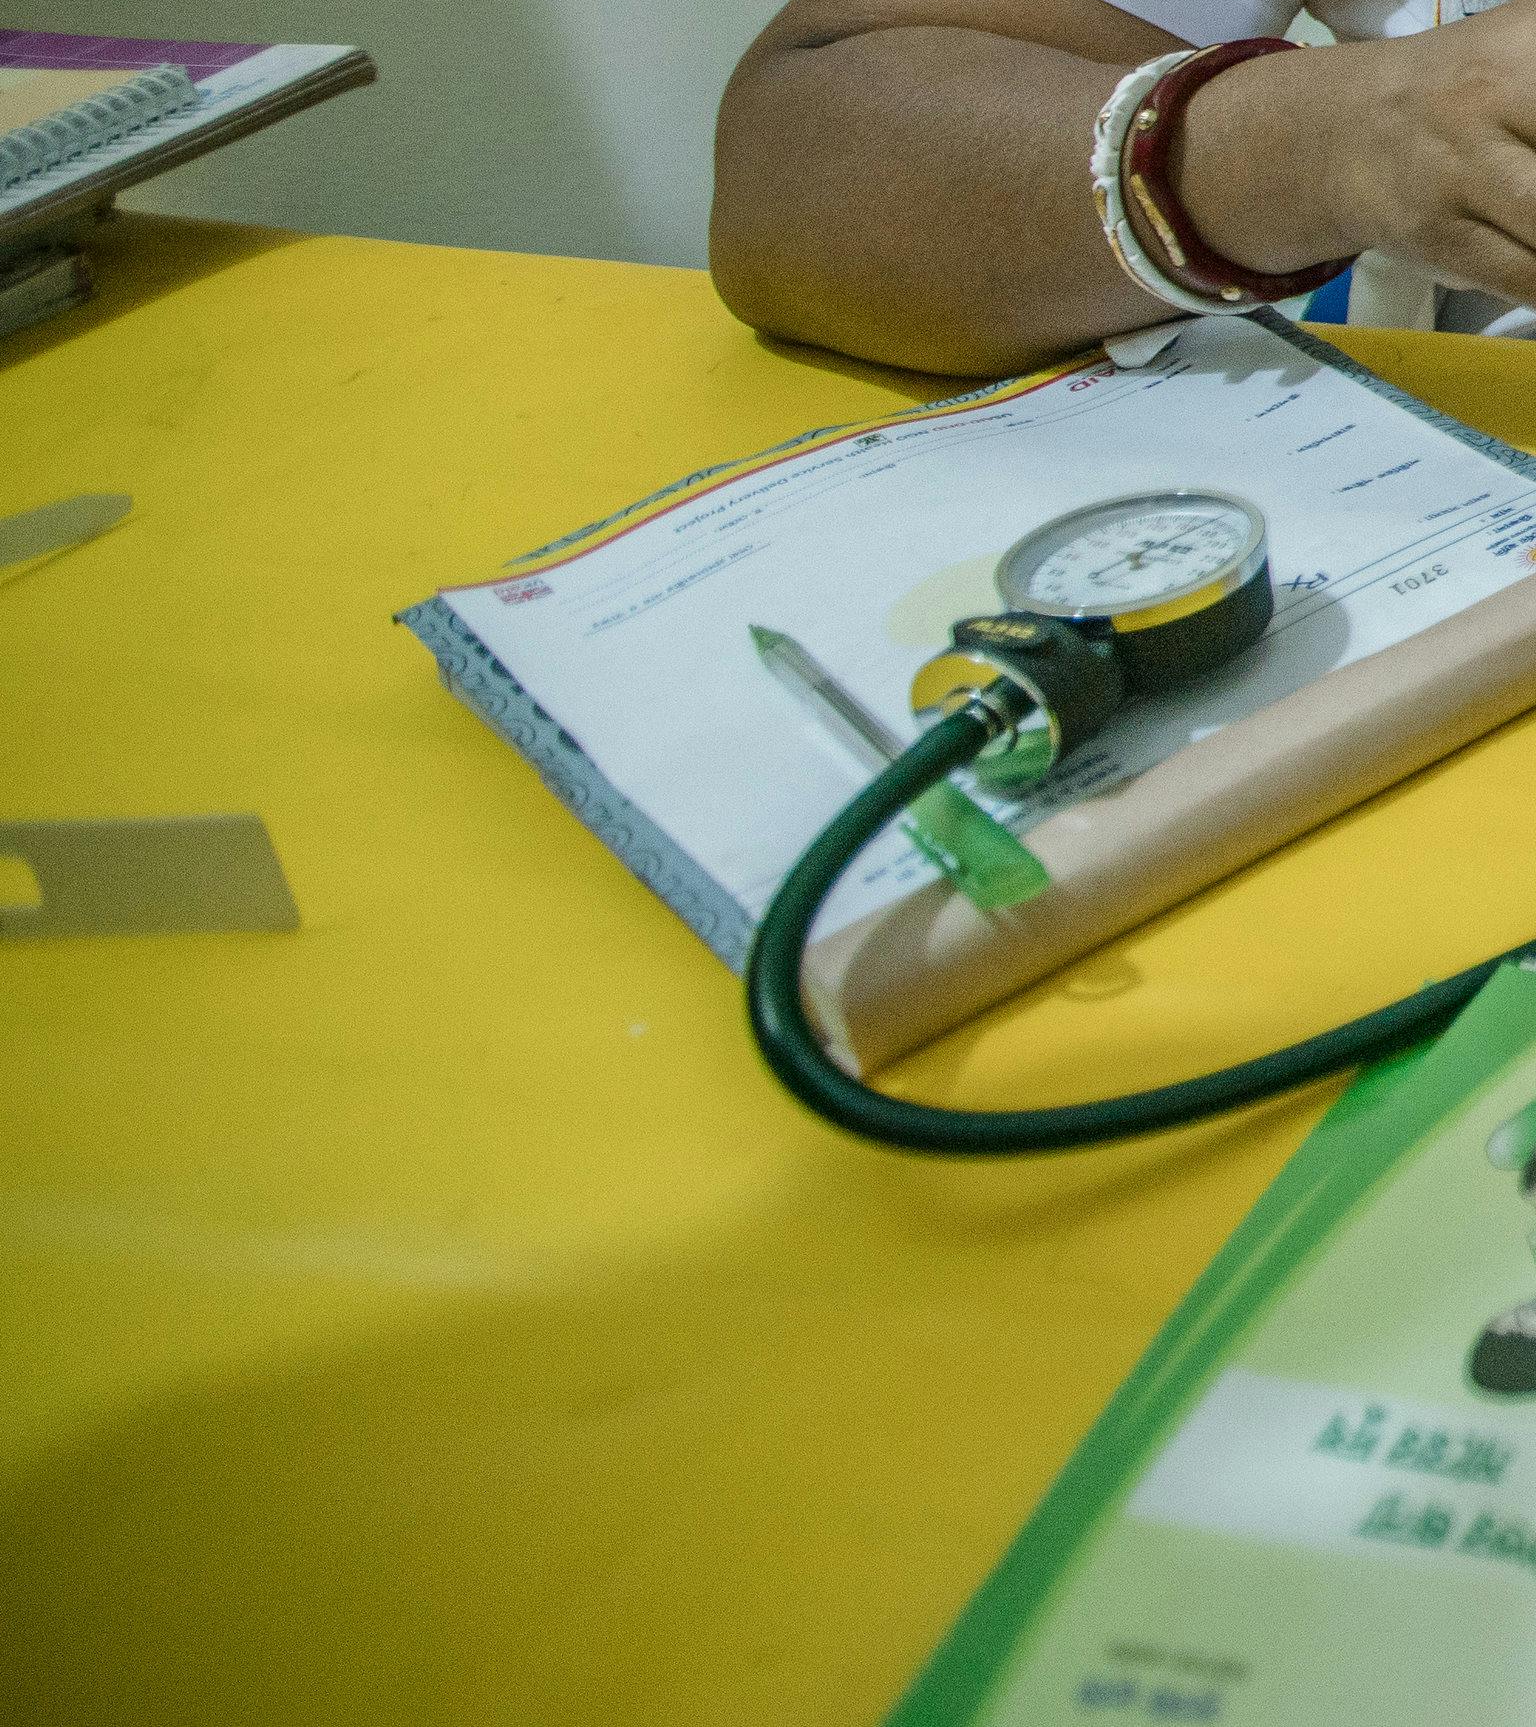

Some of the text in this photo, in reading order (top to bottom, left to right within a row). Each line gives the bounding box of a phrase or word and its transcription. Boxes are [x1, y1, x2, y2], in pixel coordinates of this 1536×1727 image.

[1068, 368, 1117, 392] AID
[793, 457, 845, 478] Service
[729, 477, 788, 506] Delivery
[675, 505, 726, 533] Project
[1390, 564, 1448, 595] 3701
